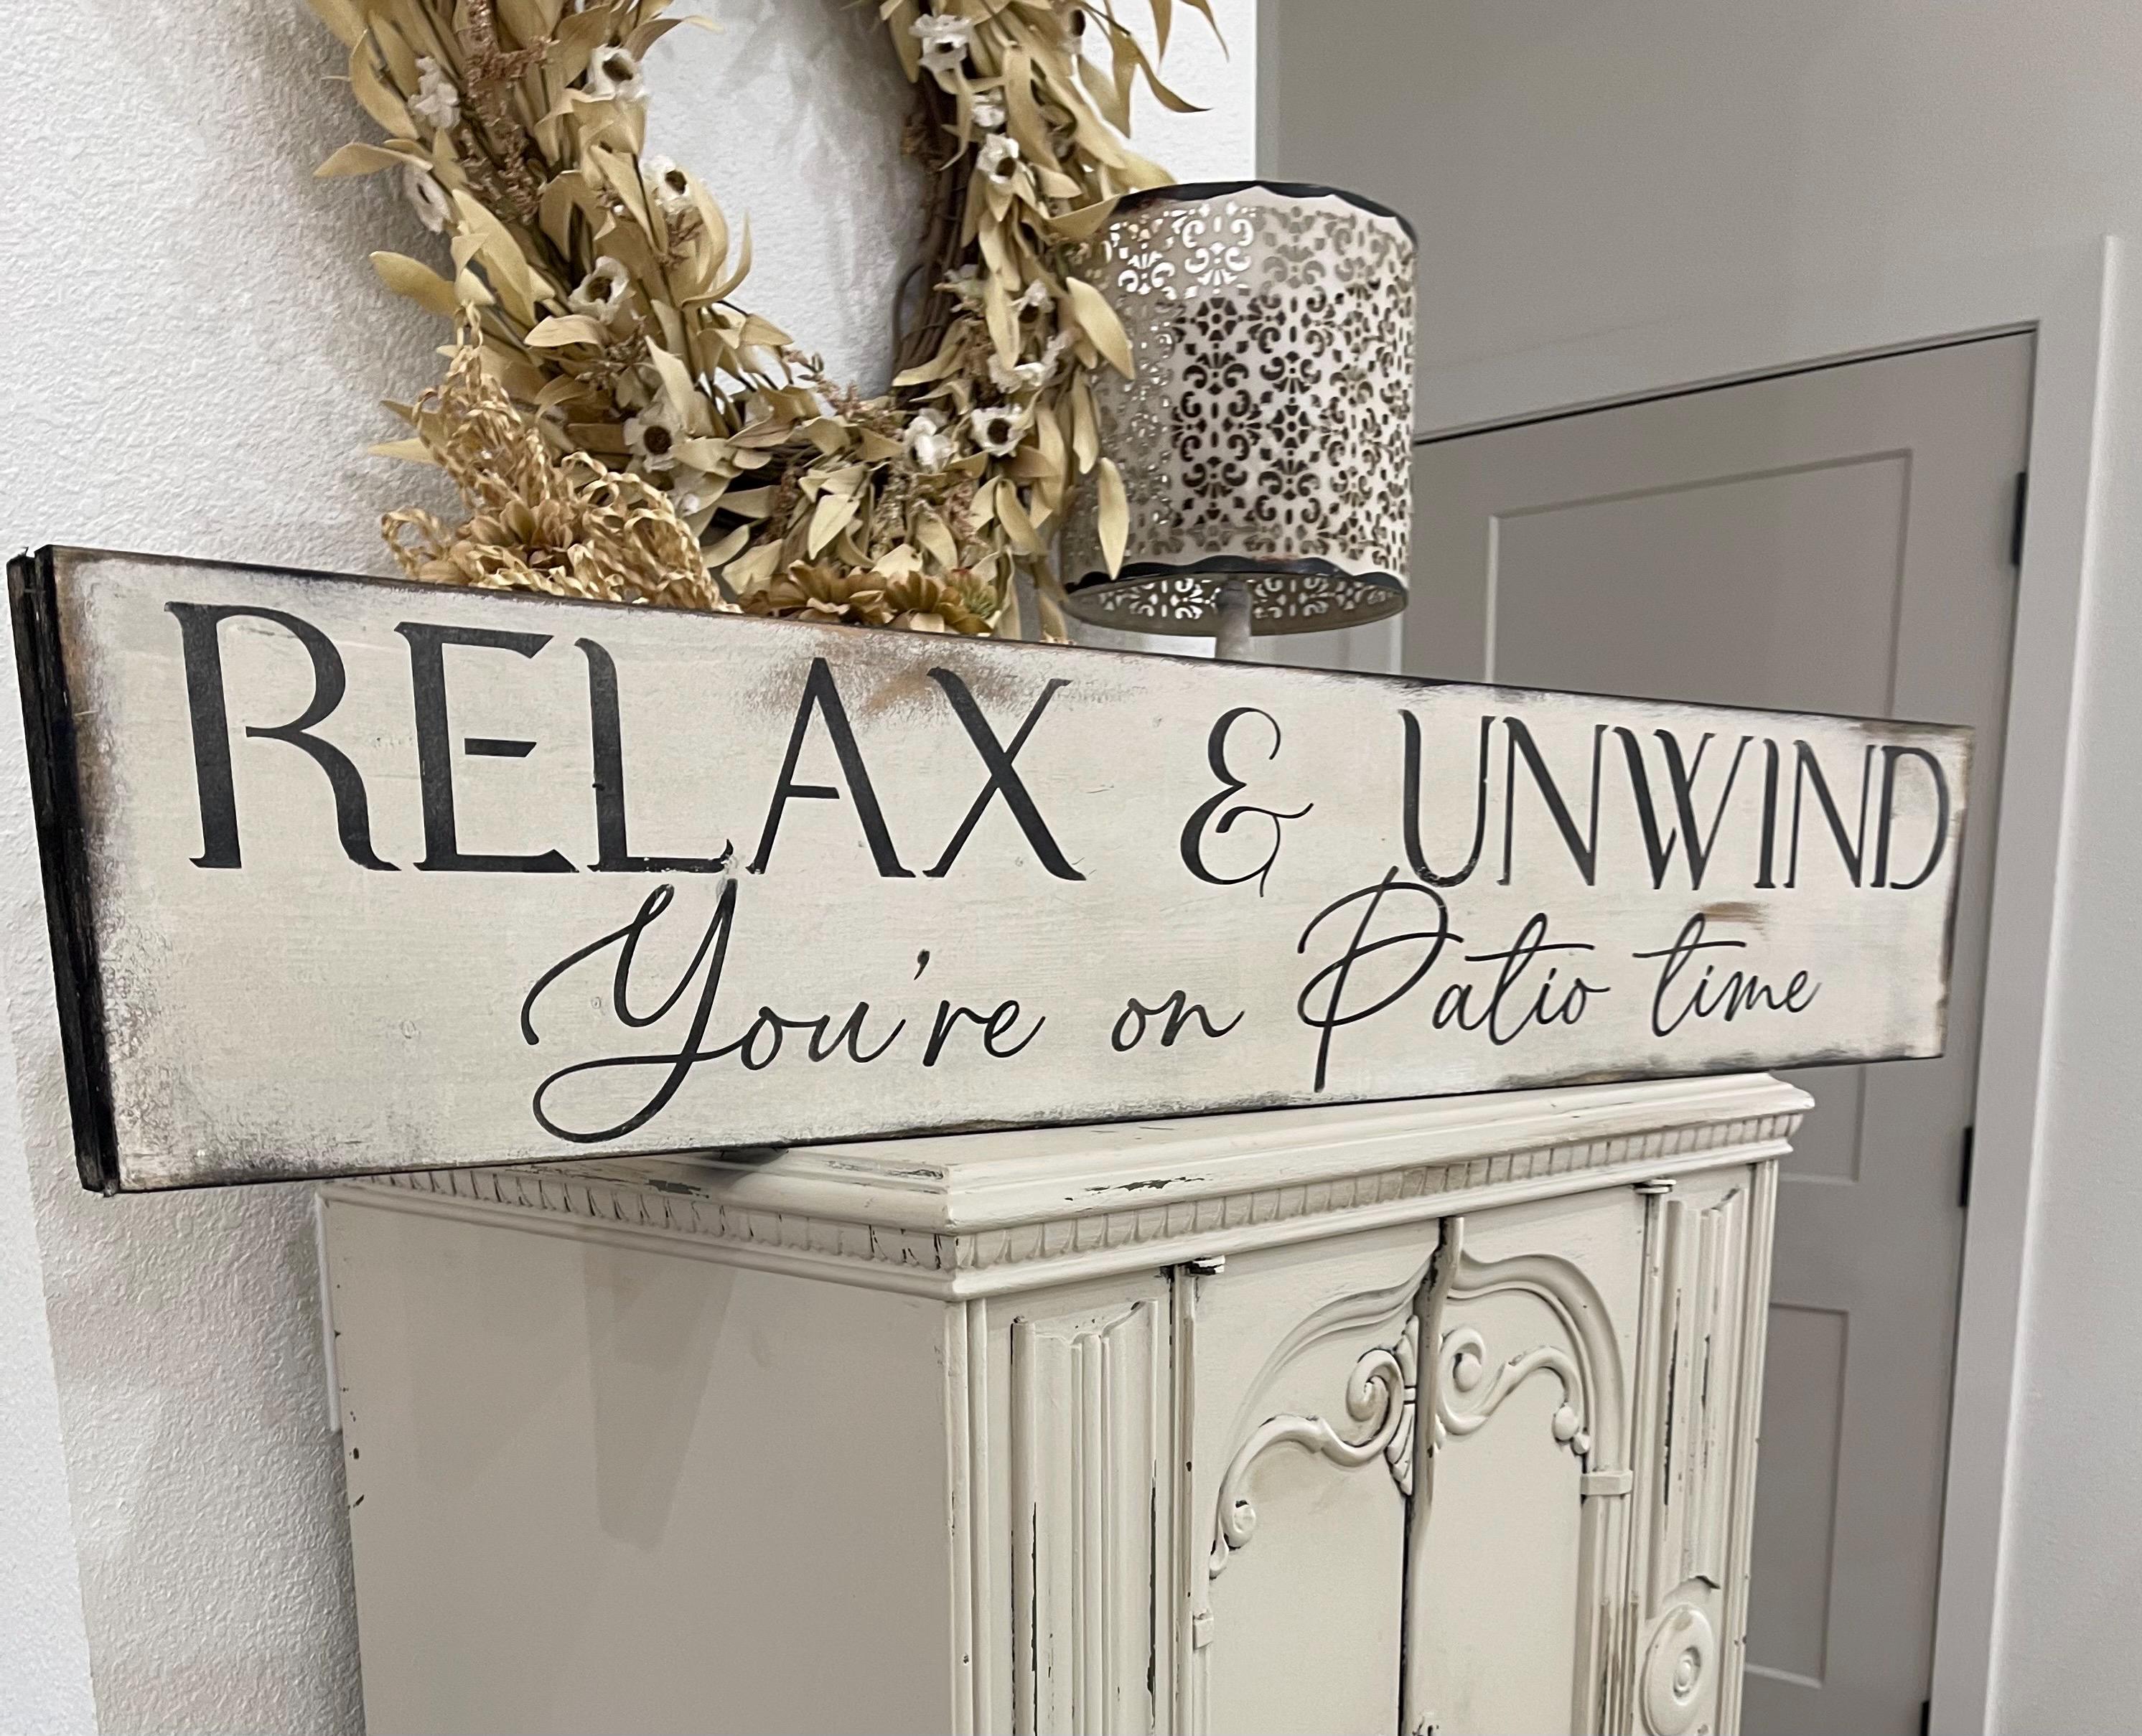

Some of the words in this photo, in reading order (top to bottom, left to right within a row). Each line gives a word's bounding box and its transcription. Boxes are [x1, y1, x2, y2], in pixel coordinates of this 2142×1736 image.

[164, 601, 1087, 881] RELAX
[1179, 707, 1314, 898] &
[1399, 709, 1950, 891] UNWIND
[520, 878, 1047, 1144] You're
[1110, 989, 1245, 1053] on
[1296, 865, 1612, 1093] Patio
[1631, 911, 1821, 1039] time
